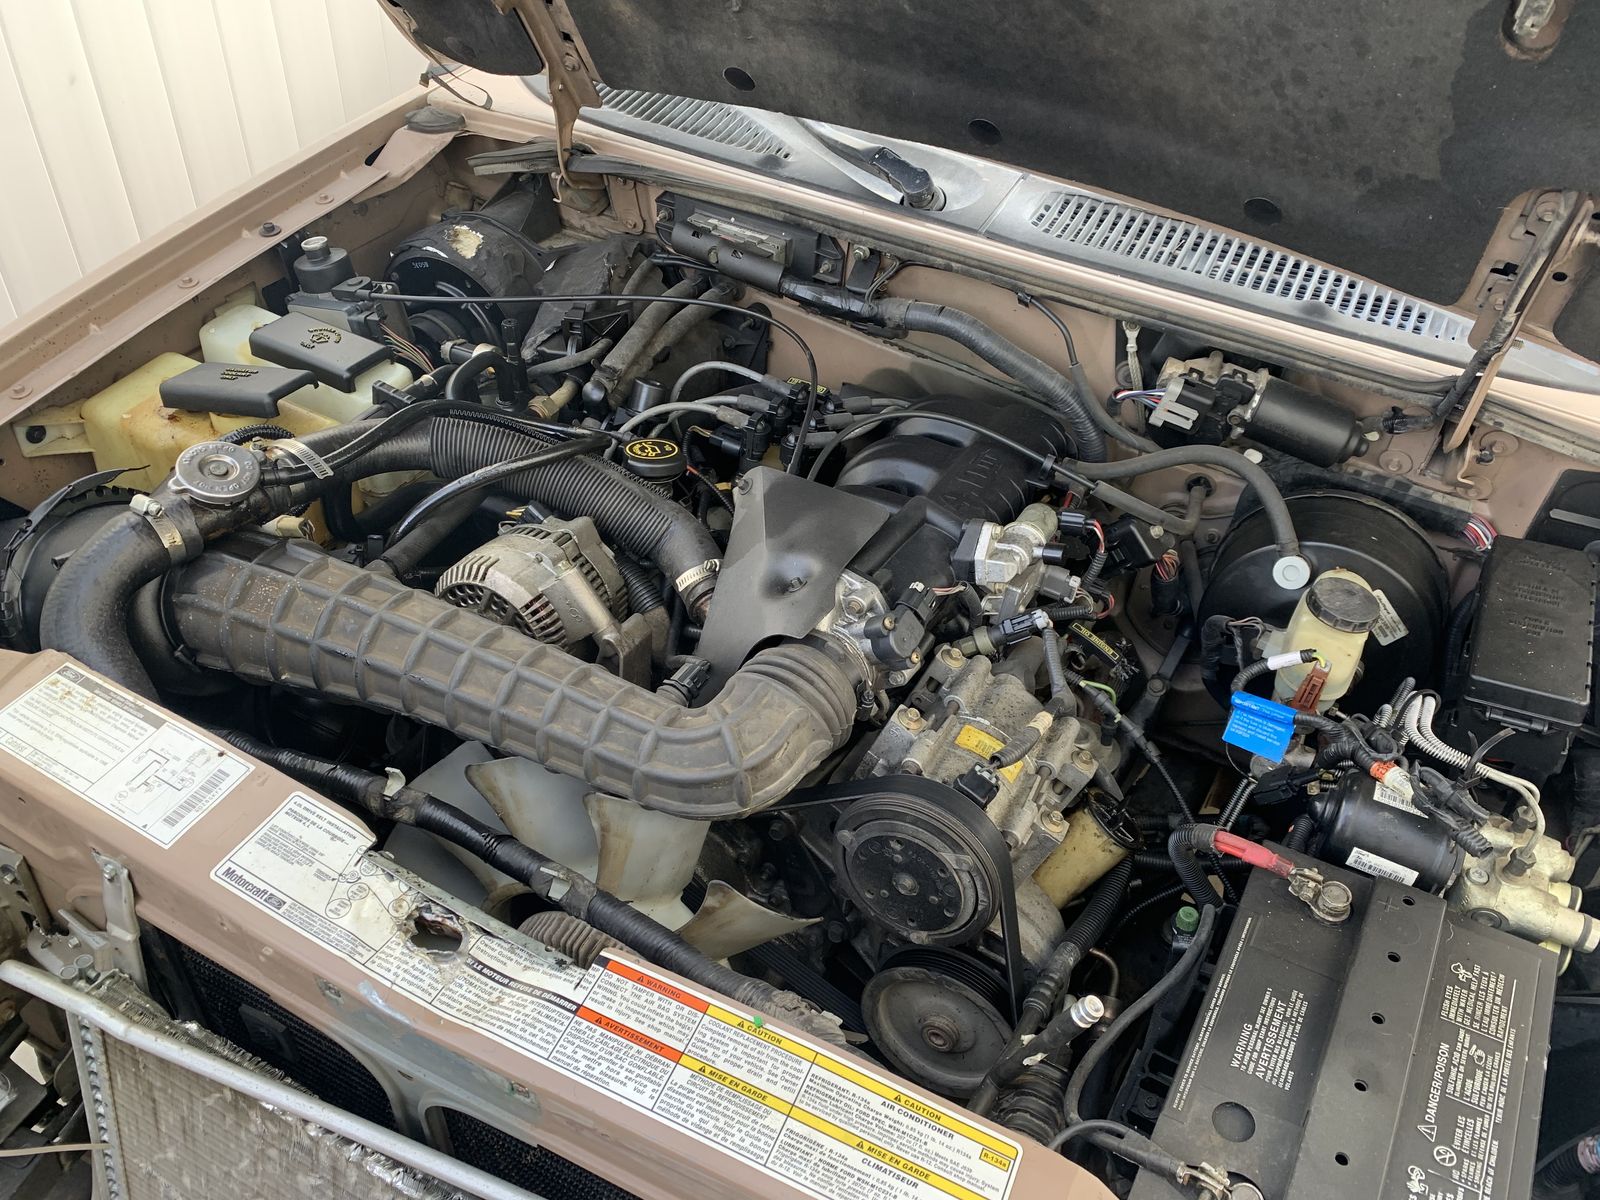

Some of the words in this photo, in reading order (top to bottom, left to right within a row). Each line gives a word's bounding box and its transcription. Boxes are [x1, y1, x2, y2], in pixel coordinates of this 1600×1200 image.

[327, 819, 357, 840] INSTALLATION
[222, 866, 269, 899] Motorcraft
[474, 963, 482, 972] LE
[482, 967, 509, 985] MOTEUR
[509, 981, 533, 994] REFUSE
[542, 990, 577, 1010] DÉMARRER
[645, 980, 681, 998] WARNING
[1472, 963, 1480, 976] FAST
[595, 984, 619, 997] WIRING.
[619, 994, 631, 1002] You
[630, 999, 646, 1010] could
[646, 1006, 665, 1018] inflate
[664, 1015, 675, 1023] the
[674, 1019, 693, 1032] bag(s)
[599, 978, 627, 993] CONNECT
[630, 991, 642, 1000] THE
[643, 997, 655, 1006] AIR
[656, 1003, 670, 1013] BAG
[672, 1010, 696, 1025] SYSTEM
[600, 993, 616, 1003] make
[623, 1004, 656, 1023] inoperative
[658, 1019, 675, 1030] which
[615, 977, 628, 986] NOT
[631, 984, 654, 997] TAMPER
[657, 996, 672, 1006] WITH
[687, 1009, 700, 1018] DIS-
[587, 995, 605, 1006] result
[613, 1007, 633, 1020] injury.
[634, 1016, 645, 1025] See
[646, 1022, 662, 1033] shop
[663, 1030, 686, 1044] manual.
[604, 1021, 664, 1052] AVERTISSEMENT
[746, 1025, 782, 1044] CAUTION
[1255, 1000, 1286, 1079] AVERTISSEMENT
[562, 1036, 576, 1046] Cela
[574, 1042, 598, 1057] pourrait
[597, 1053, 618, 1067] gonfler
[624, 1067, 635, 1075] sac
[634, 1071, 662, 1088] gonflable
[565, 1030, 599, 1049] DISPOSITIF
[598, 1046, 613, 1057] D'UN
[614, 1053, 627, 1063] SAC
[627, 1060, 665, 1081] GONFLABLE.
[569, 1025, 586, 1036] CHER
[594, 1036, 623, 1053] CÂBLAGE
[622, 1049, 660, 1071] ÉLECTRIQUE
[658, 1067, 669, 1075] DU
[584, 1024, 597, 1033] PAS
[598, 1031, 633, 1051] MANIPULER
[644, 1052, 673, 1069] DÉBRAN-
[686, 1048, 717, 1066] procedure.
[693, 1035, 721, 1052] operation
[728, 1052, 743, 1062] your
[743, 1058, 766, 1072] vehicle.
[767, 1069, 778, 1078] See
[779, 1075, 798, 1087] Owner
[696, 1029, 707, 1038] ing
[708, 1035, 729, 1048] system
[740, 1049, 768, 1066] important
[770, 1063, 779, 1071] for
[781, 1069, 801, 1082] proper
[699, 1023, 727, 1039] Complete
[726, 1035, 749, 1049] removal
[756, 1048, 765, 1056] air
[765, 1052, 779, 1063] from
[779, 1059, 789, 1067] the
[789, 1064, 805, 1074] cool-
[708, 1019, 732, 1033] COOLANT
[732, 1030, 770, 1050] REPLACEMENT
[770, 1047, 802, 1065] PROCEDURE
[1230, 1024, 1252, 1068] WARNING
[551, 1054, 573, 1068] manuel
[579, 1068, 611, 1087] réparation.
[690, 1041, 708, 1053] Guide
[711, 1051, 721, 1059] for
[723, 1057, 743, 1071] proper
[746, 1067, 763, 1079] drain
[765, 1076, 778, 1086] and
[780, 1083, 795, 1094] refill
[708, 1069, 727, 1082] MISE
[728, 1079, 740, 1088] EN
[740, 1084, 768, 1102] GARDE
[810, 1073, 851, 1095] REFRIGERANT:
[851, 1093, 870, 1104] R-134a
[1425, 1042, 1450, 1123] DANGER/POISON
[677, 1083, 695, 1095] purge
[722, 1104, 731, 1112] du
[730, 1108, 750, 1121] circuit
[758, 1122, 778, 1135] refroi-
[686, 1078, 709, 1093] CIRCUIT
[708, 1089, 716, 1097] DE
[716, 1093, 767, 1122] REFROIDISSEMENT
[715, 1085, 724, 1093] DE
[723, 1089, 762, 1111] REMPLISSAGE
[762, 1107, 772, 1116] DU
[805, 1084, 842, 1104] REFRIGERANT
[855, 1108, 870, 1118] FORD
[808, 1078, 834, 1093] Maximum
[834, 1090, 862, 1106] Operating
[862, 1104, 882, 1116] Charge
[883, 1114, 904, 1127] Weight:
[880, 1100, 896, 1111] AIR
[896, 1108, 955, 1140] CONDITIONER
[903, 1100, 941, 1121] CAUTION
[861, 1157, 919, 1189] CLIMATISEUR
[866, 1145, 888, 1159] MISE
[888, 1156, 901, 1166] EN
[901, 1162, 930, 1180] GARDE
[982, 1152, 1007, 1167] R-134a
